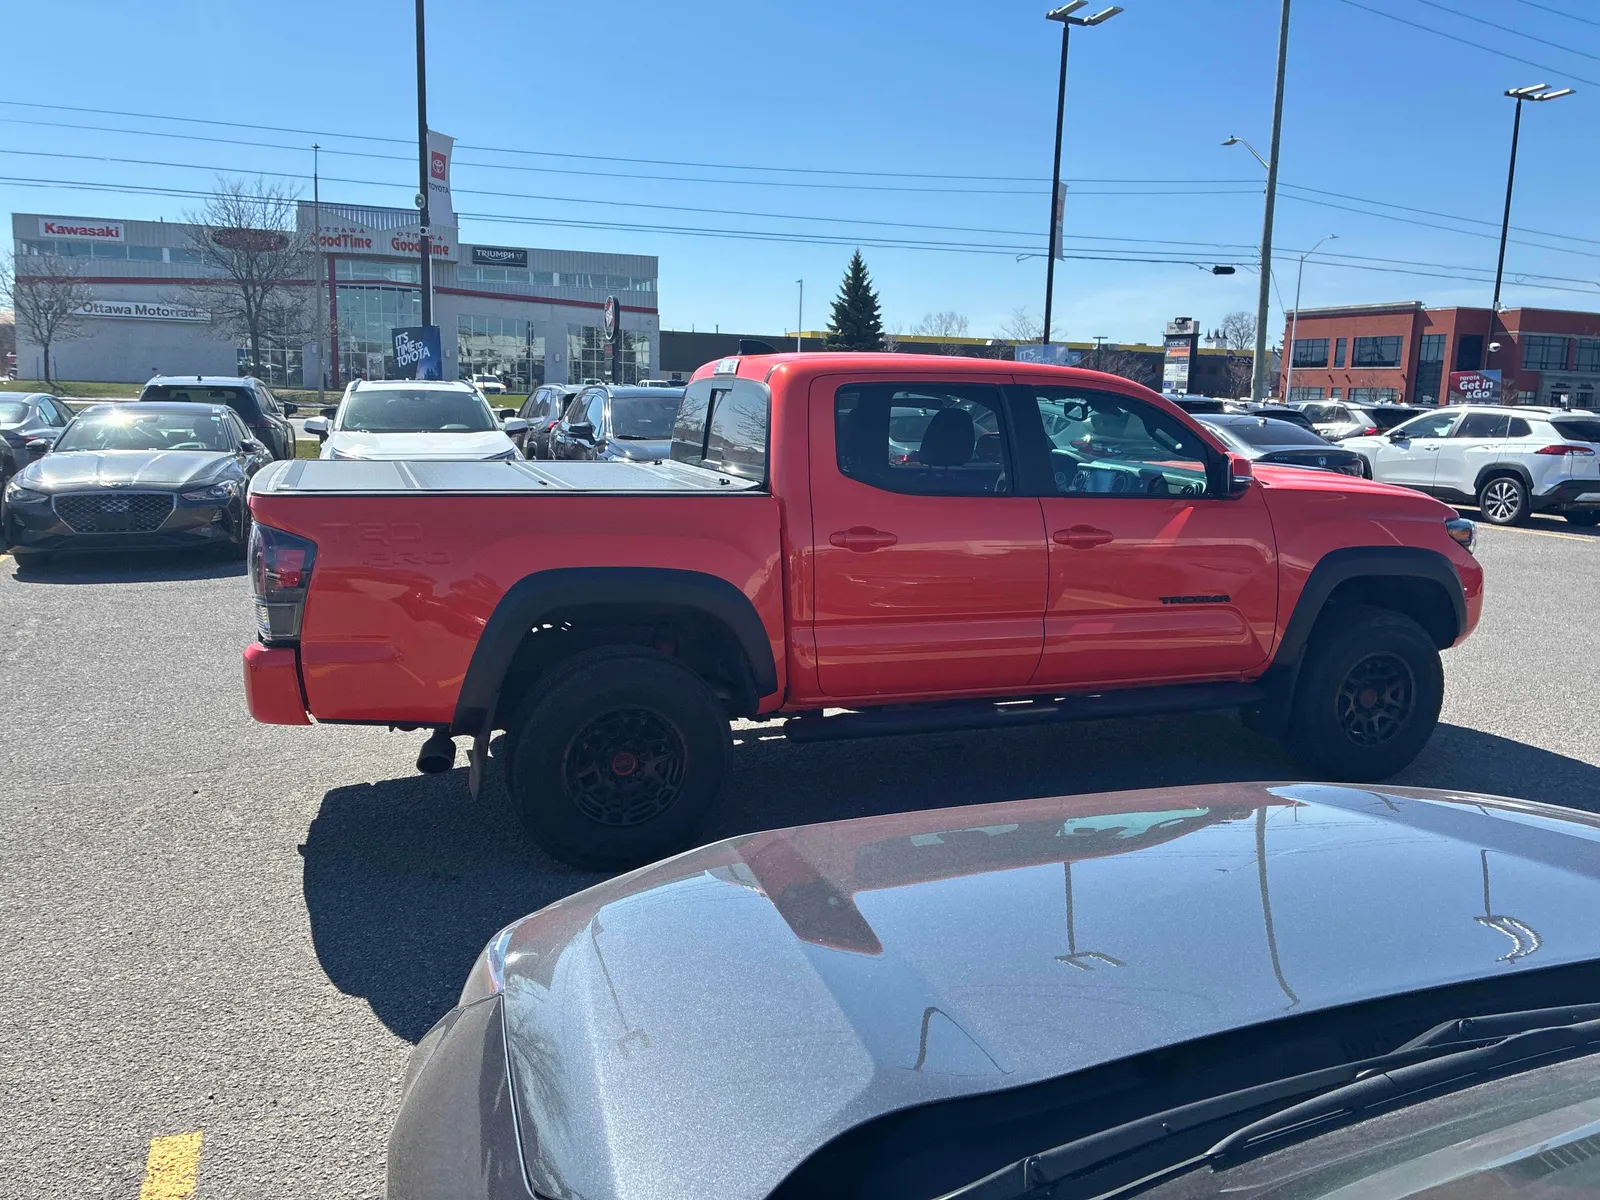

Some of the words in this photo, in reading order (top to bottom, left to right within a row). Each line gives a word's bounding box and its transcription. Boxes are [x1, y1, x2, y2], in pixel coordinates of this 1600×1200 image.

[428, 182, 450, 194] TOYOTA
[44, 222, 120, 238] Kawasaki
[396, 231, 444, 241] OTTWA
[391, 237, 449, 256] Goodime
[476, 249, 515, 260] TRIUMPH
[82, 301, 132, 316] Ottawa
[135, 304, 197, 318] Motorrad
[396, 340, 415, 357] TIME
[397, 347, 430, 367] TOYOTA
[1460, 380, 1480, 390] Get
[1482, 379, 1494, 389] in
